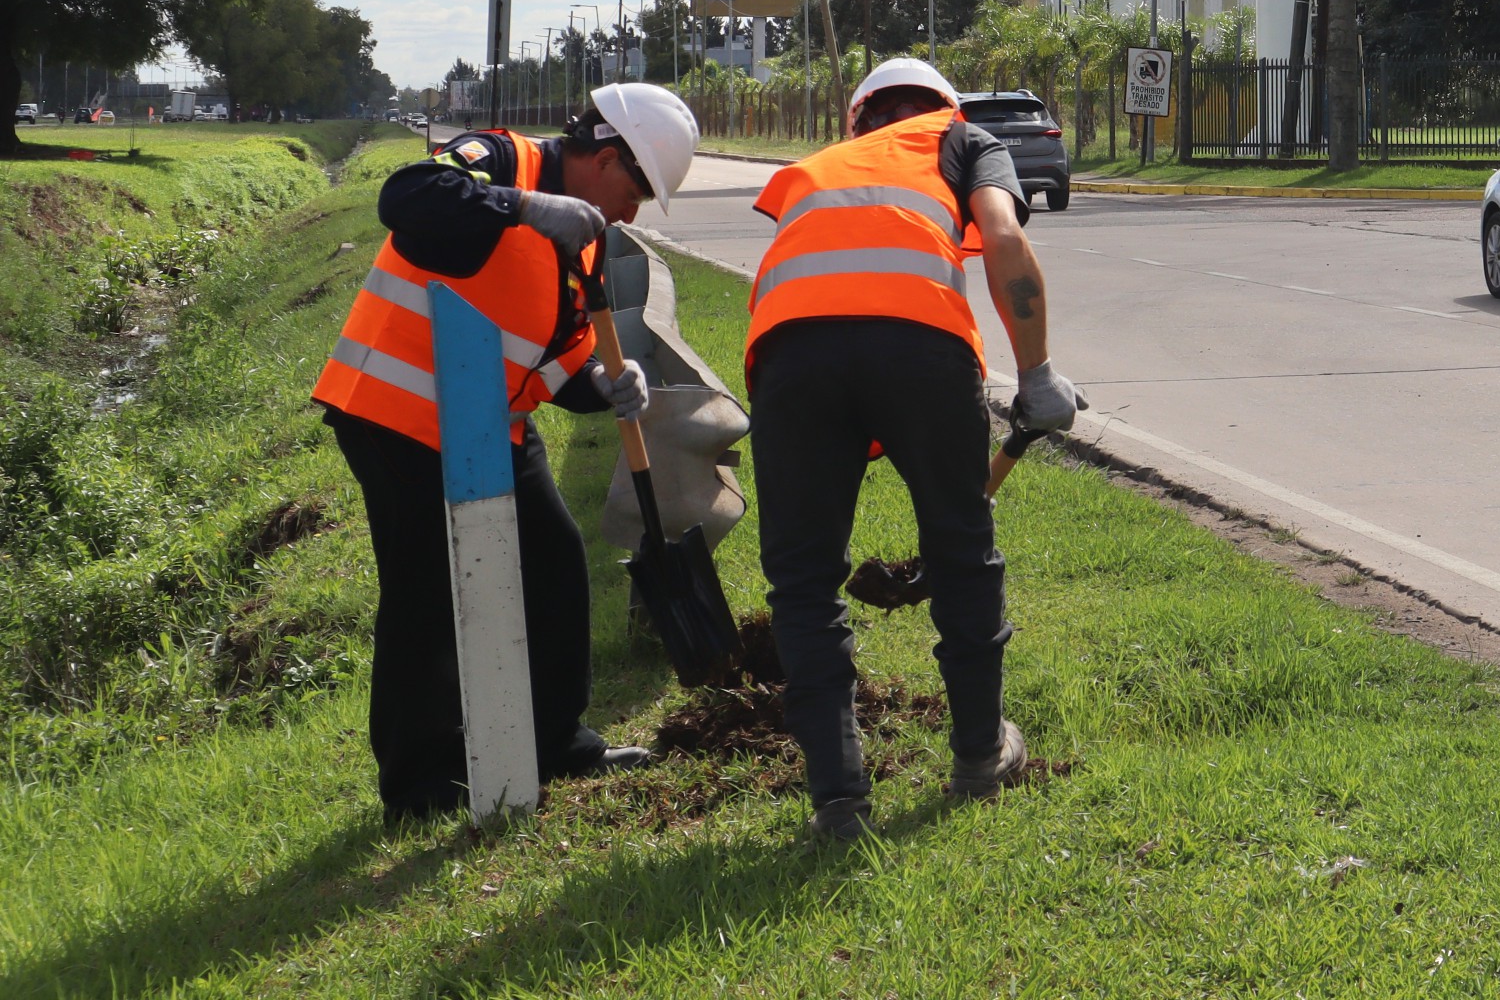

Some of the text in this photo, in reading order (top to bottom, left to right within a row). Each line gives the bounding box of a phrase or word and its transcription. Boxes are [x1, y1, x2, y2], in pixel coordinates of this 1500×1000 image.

[1131, 85, 1165, 95] PROHIBIDO
[1132, 92, 1164, 102] TRANSITO
[1134, 100, 1160, 109] PESADO
